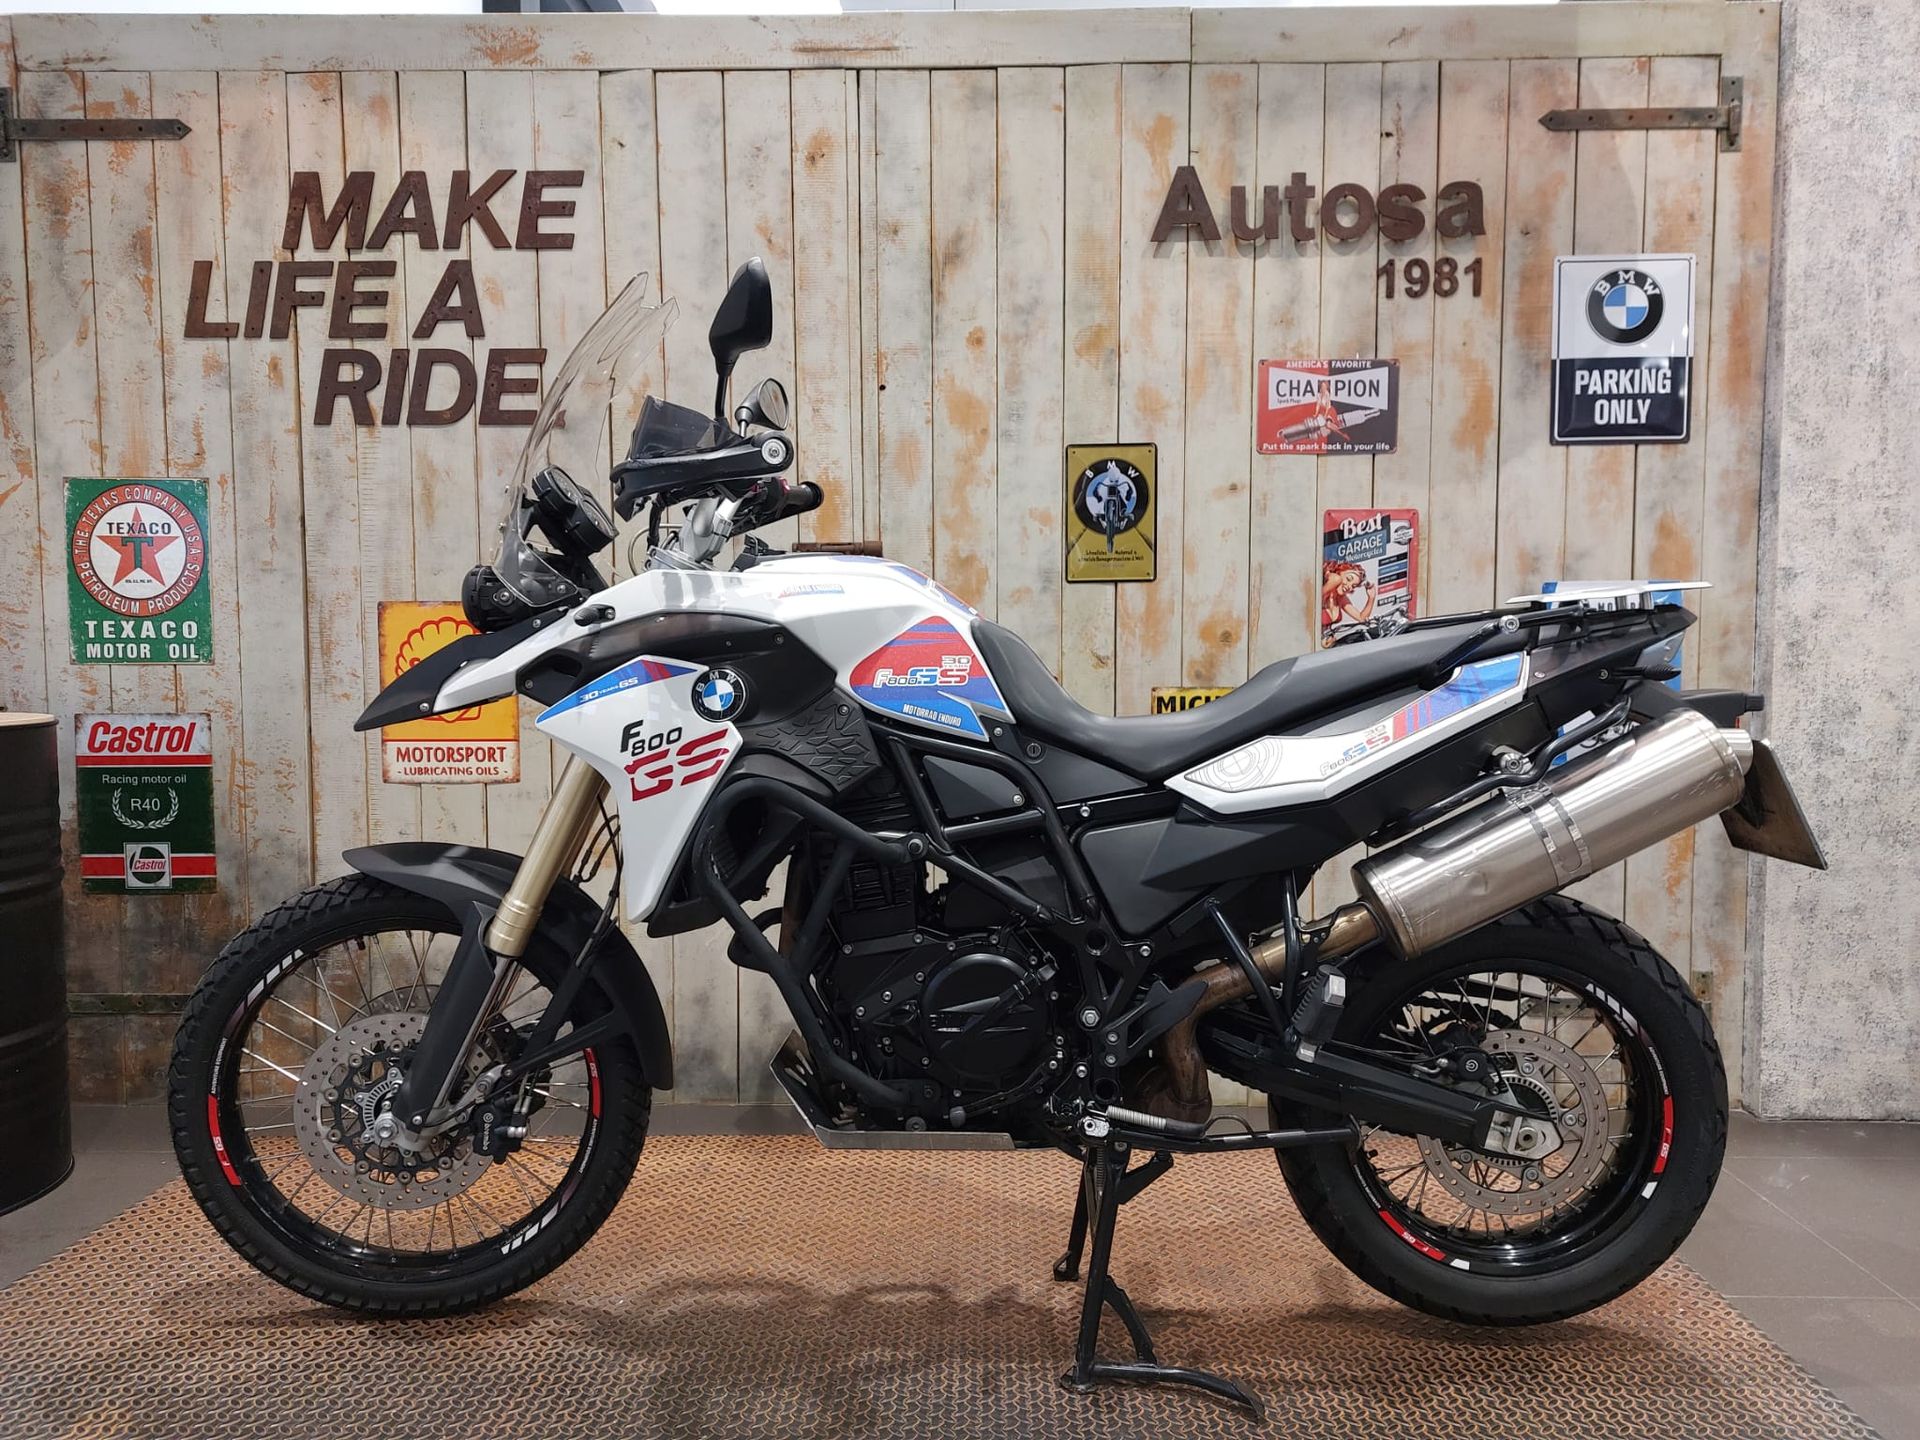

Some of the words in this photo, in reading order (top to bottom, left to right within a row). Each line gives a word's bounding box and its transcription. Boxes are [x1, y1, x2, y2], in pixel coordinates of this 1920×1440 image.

[282, 170, 584, 250] MAKE
[1150, 165, 1487, 243] Autosa
[1378, 257, 1483, 299] 1981
[1594, 270, 1660, 297] BMW
[184, 260, 397, 338] LIFE
[412, 259, 486, 338] A
[1286, 360, 1329, 369] AMERICA'S
[1331, 360, 1372, 369] FAVORITE
[1575, 368, 1672, 396] PARKING
[1594, 398, 1651, 425] ONLY
[1263, 443, 1277, 451] Put
[1296, 443, 1320, 451] spark
[1354, 443, 1374, 452] your
[1376, 442, 1390, 450] life
[1085, 460, 1140, 479] BMW
[74, 530, 89, 556] THE
[82, 491, 120, 527] TEXAS
[124, 487, 188, 519] COMPANY
[106, 522, 172, 535] TEXACO
[1340, 512, 1383, 540] Best
[121, 536, 154, 569] T
[1338, 533, 1384, 557] GARAGE
[76, 562, 140, 614] PETROLEUM
[147, 562, 200, 614] PRODUCTS
[85, 620, 199, 639] TEXACO
[86, 643, 151, 659] MOTOR
[168, 643, 200, 659] OIL
[942, 656, 970, 665] 30
[579, 690, 599, 703] 30
[619, 676, 639, 689] GS
[696, 671, 737, 693] BMW
[903, 704, 938, 721] MOTORRAD
[938, 713, 962, 728] ENDURO
[87, 721, 197, 753] Castrol
[396, 746, 507, 764] MOTORSPORT
[623, 728, 730, 802] GS
[102, 774, 139, 786] Racing
[141, 775, 171, 784] motor
[174, 774, 187, 784] oil
[403, 766, 473, 776] LUBRICATING
[475, 766, 500, 776] OILS
[130, 798, 161, 812] R40
[133, 858, 167, 871] Castrol
